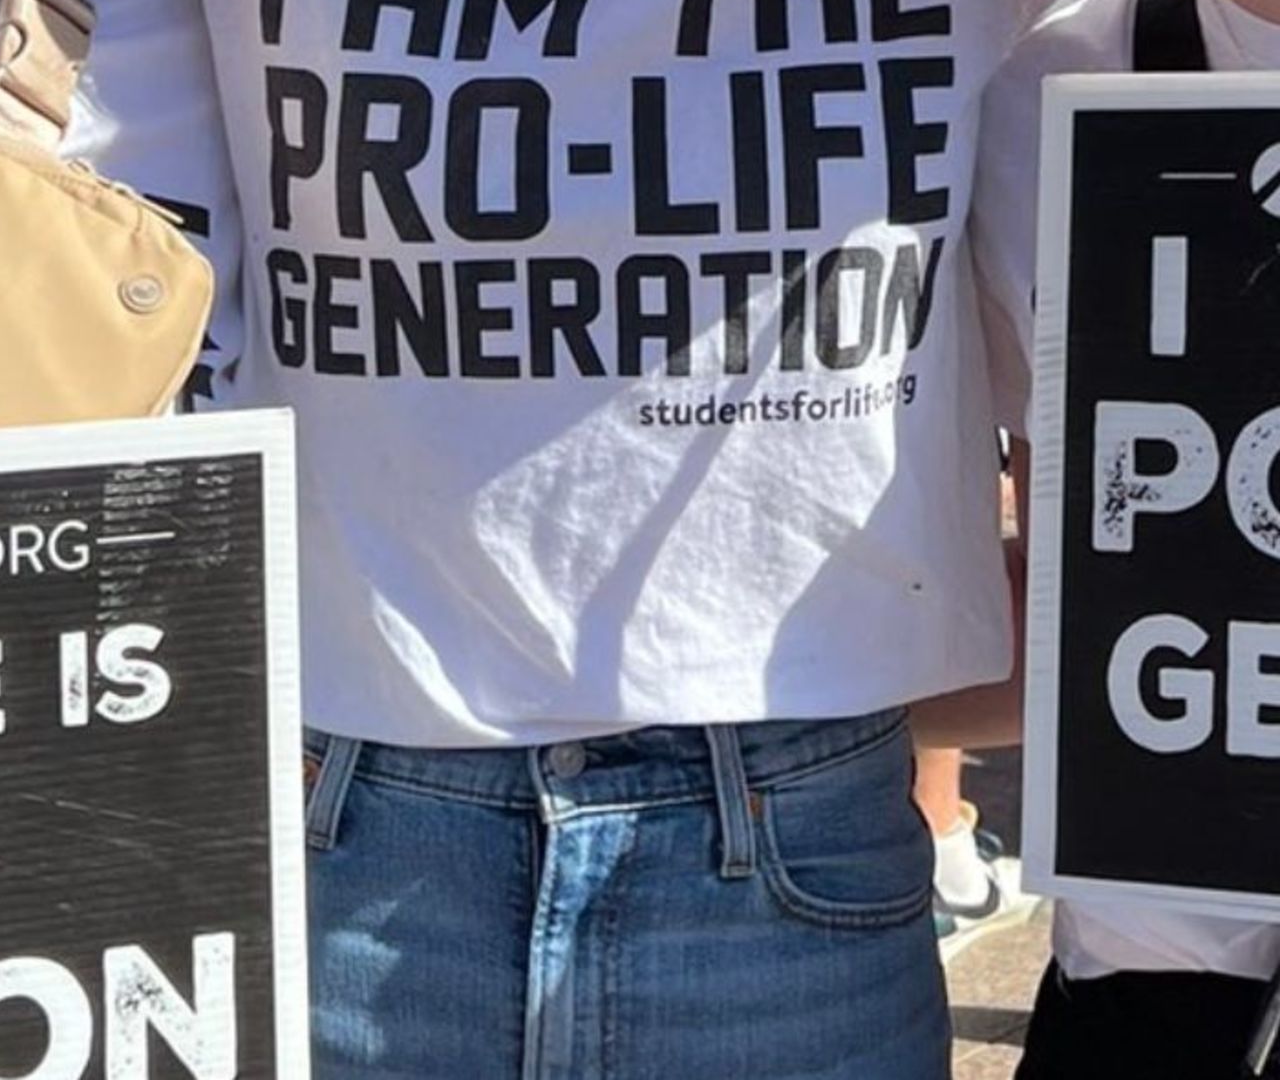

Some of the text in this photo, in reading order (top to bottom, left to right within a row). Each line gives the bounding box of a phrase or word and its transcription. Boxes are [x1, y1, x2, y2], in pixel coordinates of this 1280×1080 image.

[264, 55, 956, 243] PRO-LIFE
[265, 236, 946, 379] GENERATION
[1149, 235, 1188, 357] I
[58, 621, 174, 728] IS
